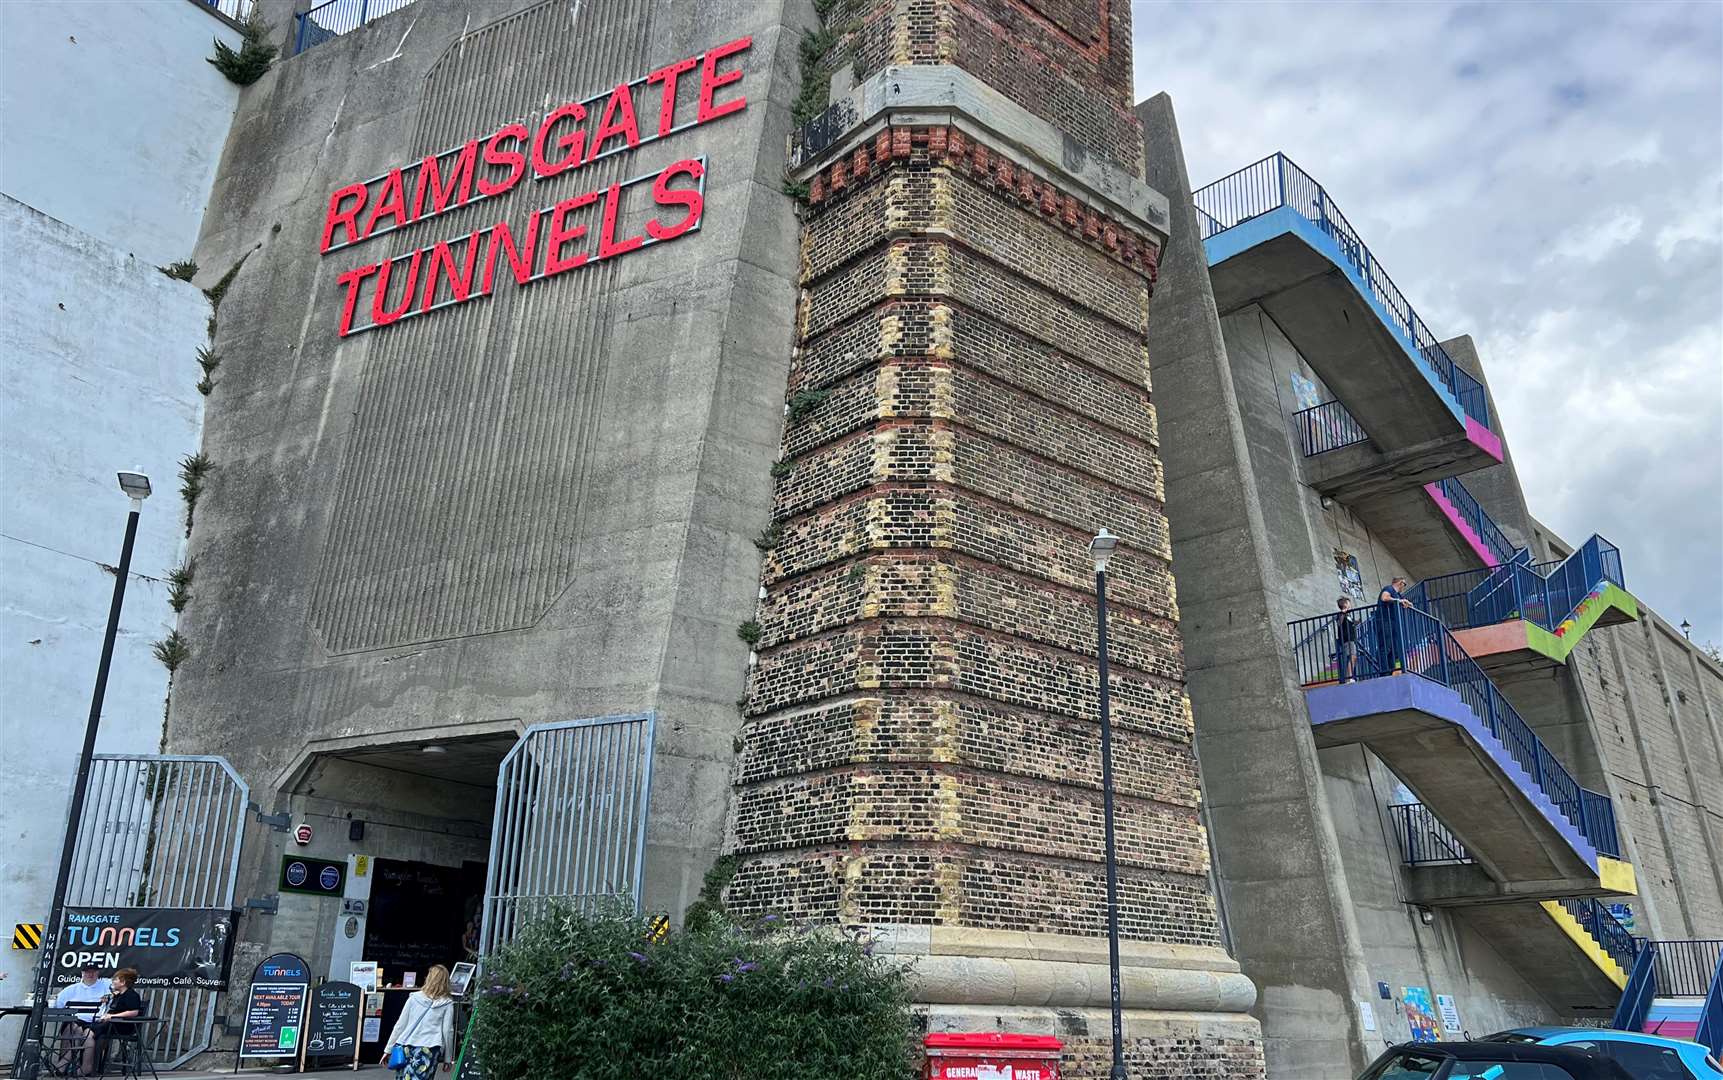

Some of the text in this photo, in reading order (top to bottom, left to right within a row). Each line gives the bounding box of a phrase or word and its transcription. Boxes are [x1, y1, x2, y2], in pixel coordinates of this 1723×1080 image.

[320, 36, 753, 255] RAMSGATE
[336, 158, 705, 337] TUNNELS
[68, 914, 121, 924] RAMSGATE
[61, 951, 120, 969] OPEN
[57, 974, 81, 983] Guide
[1015, 1069, 1040, 1080] WASTE
